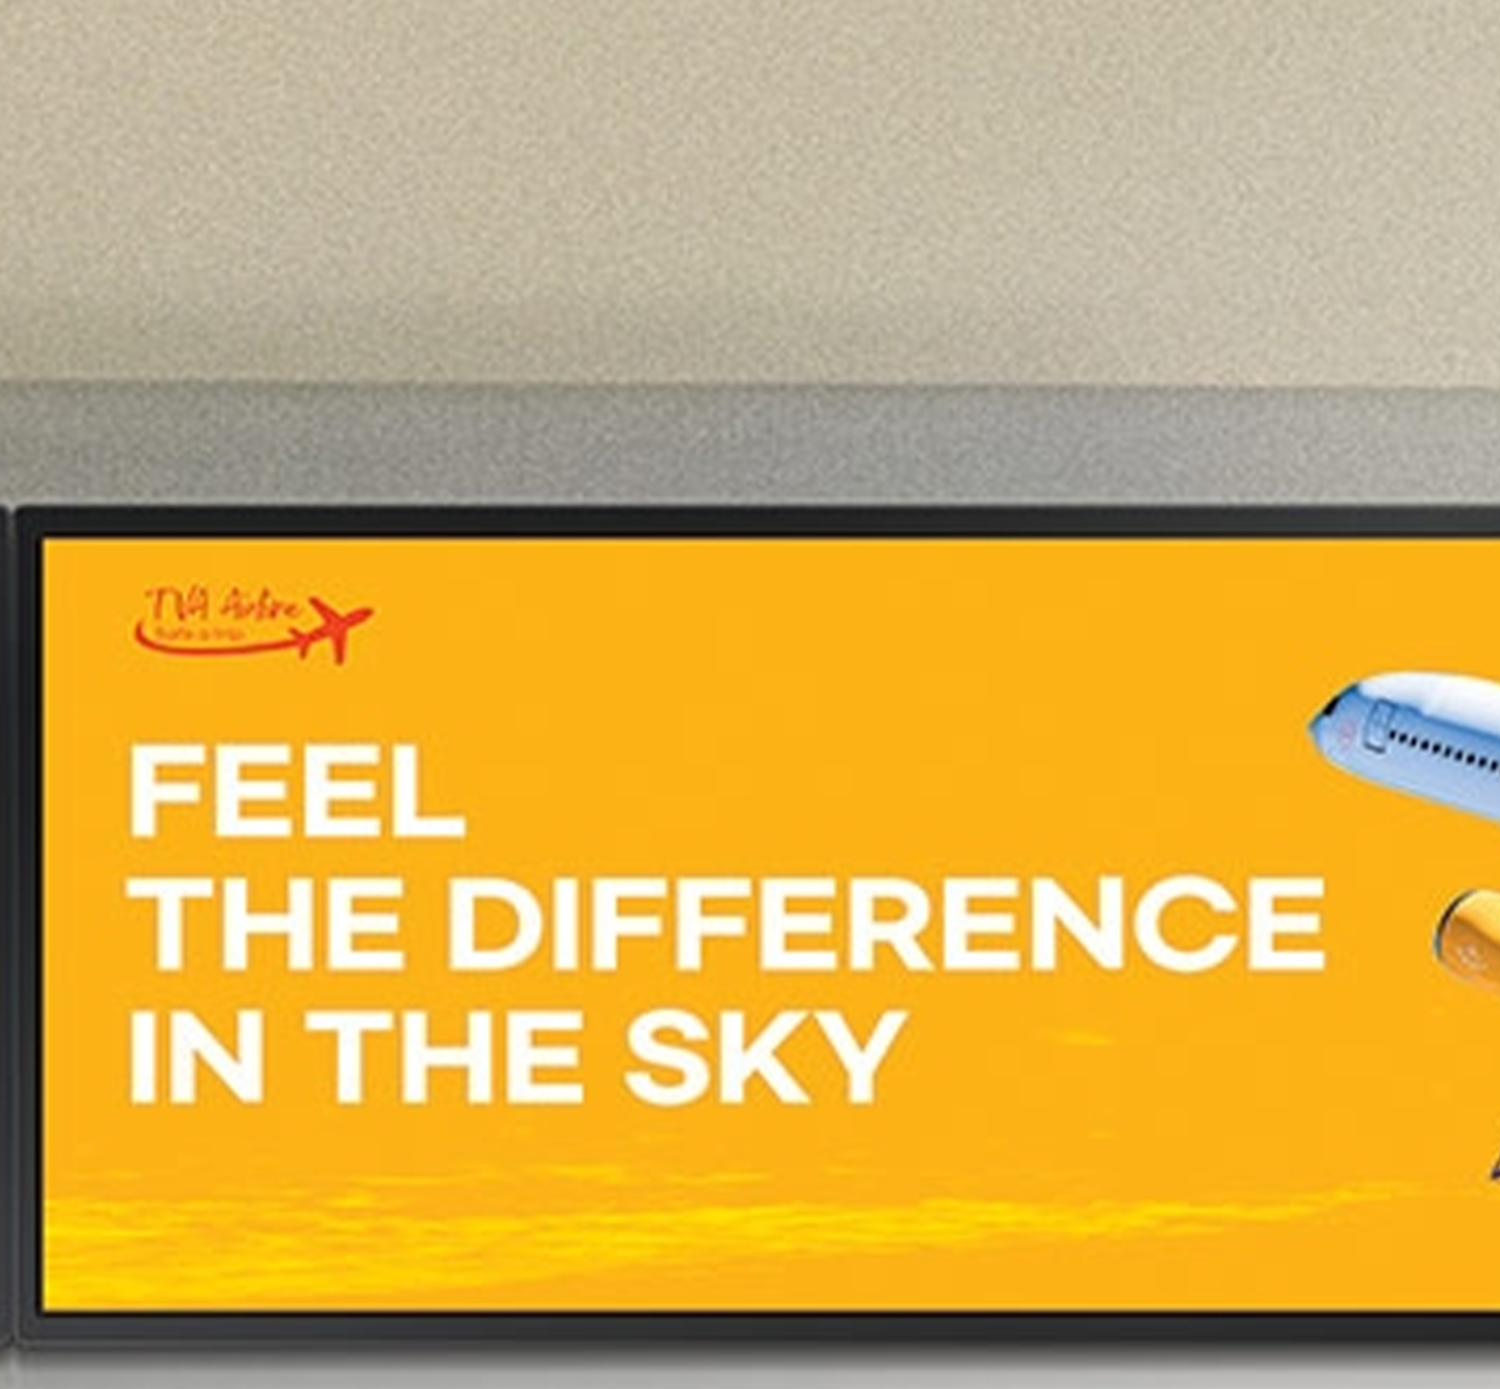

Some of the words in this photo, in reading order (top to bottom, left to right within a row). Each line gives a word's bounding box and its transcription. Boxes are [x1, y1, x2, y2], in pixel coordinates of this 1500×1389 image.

[132, 745, 465, 836] FEEL
[127, 878, 404, 969] THE
[450, 875, 1324, 971] DIFFERENCE
[132, 1011, 261, 1102] IN
[306, 1012, 583, 1103] THE
[626, 1009, 906, 1105] SKY
